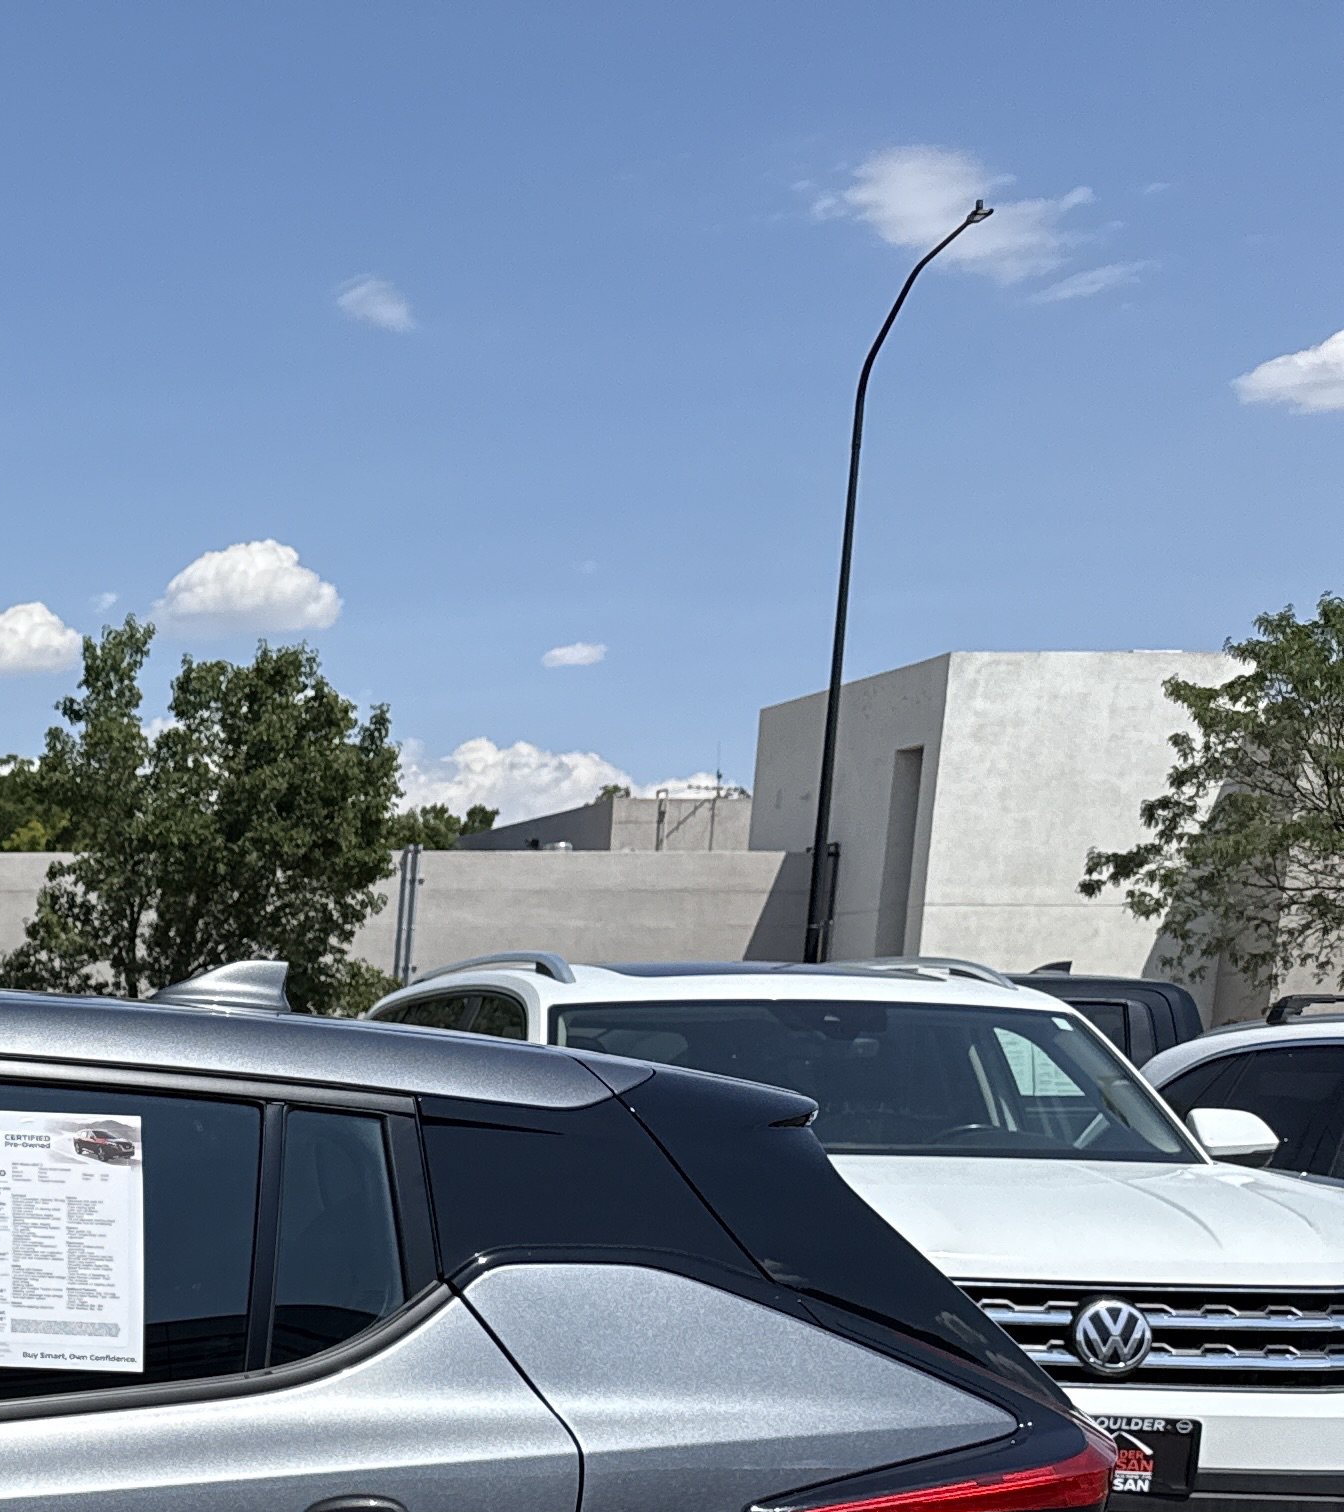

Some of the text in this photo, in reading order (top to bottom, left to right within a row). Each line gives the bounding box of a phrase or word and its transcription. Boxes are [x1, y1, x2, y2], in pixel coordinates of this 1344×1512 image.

[22, 1351, 38, 1359] Buy
[40, 1352, 67, 1360] Smart,
[1092, 1416, 1166, 1431] OULDER
